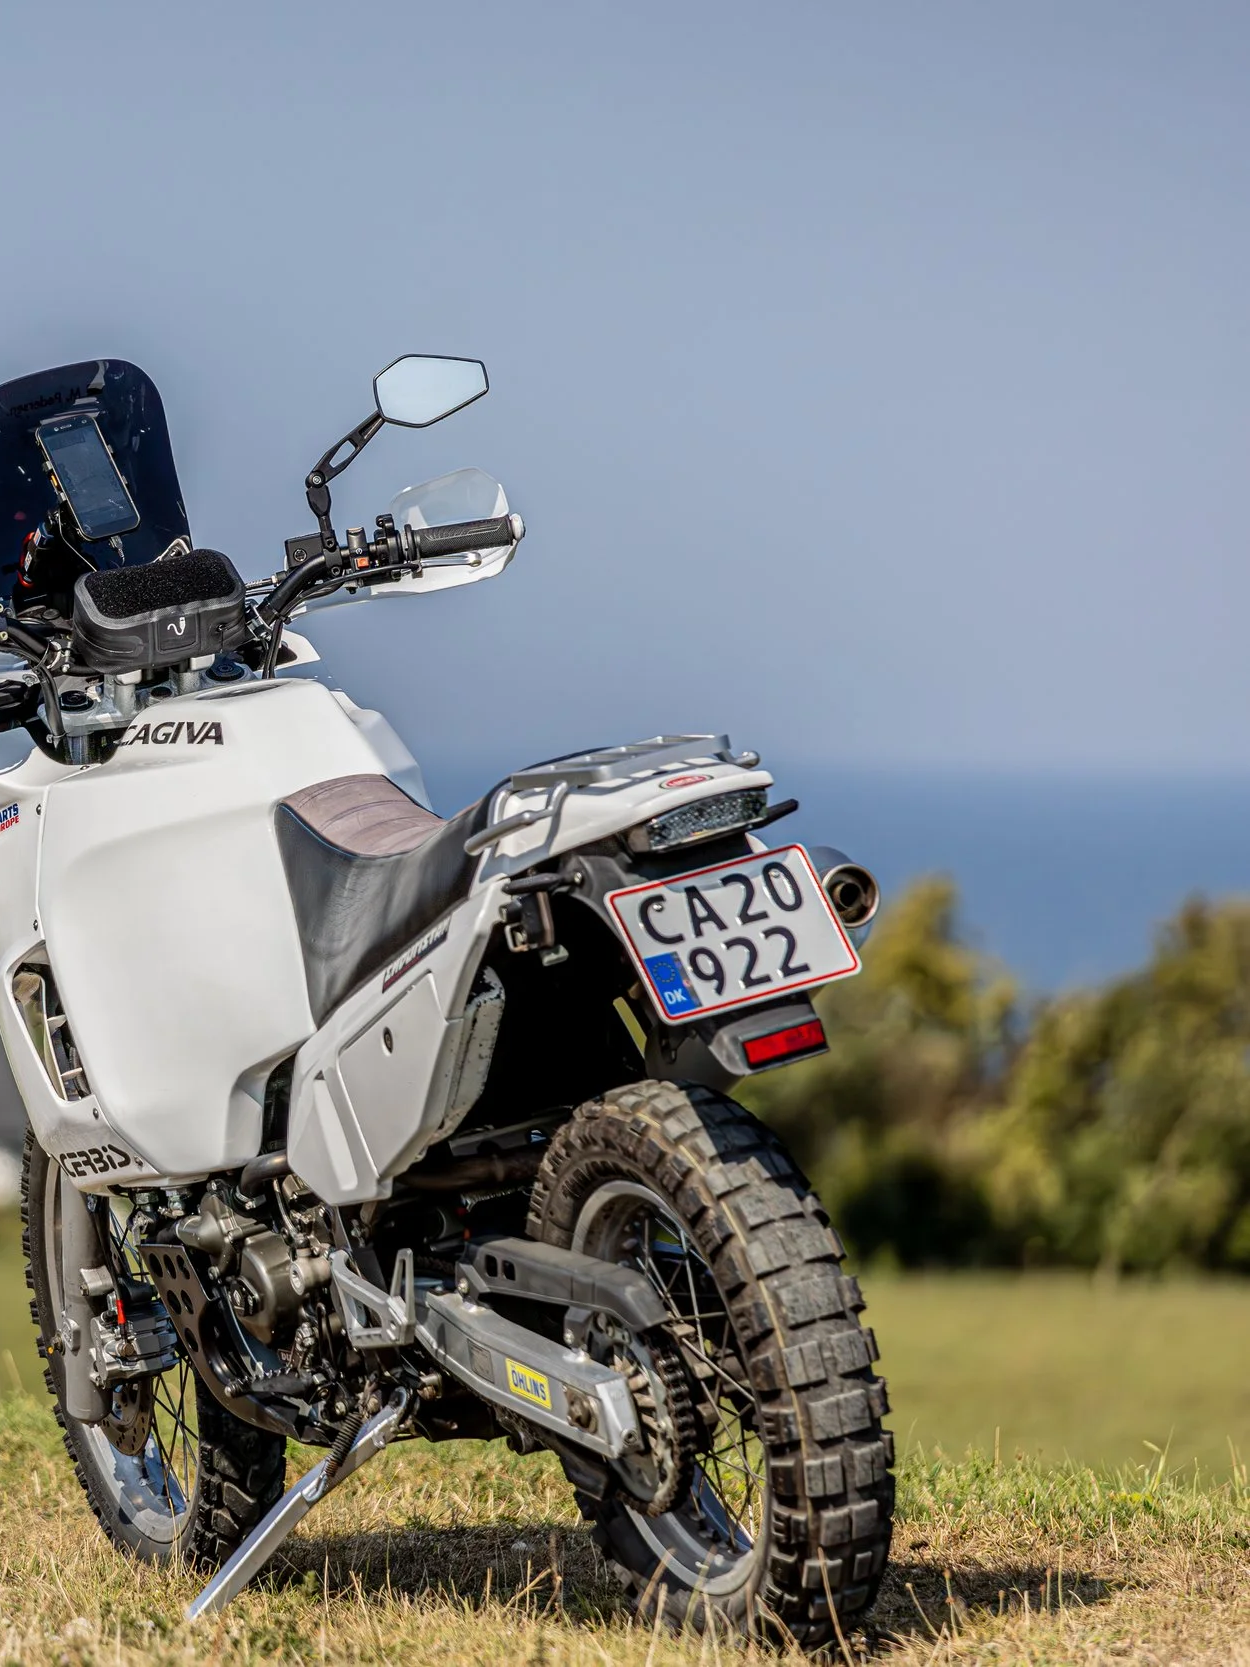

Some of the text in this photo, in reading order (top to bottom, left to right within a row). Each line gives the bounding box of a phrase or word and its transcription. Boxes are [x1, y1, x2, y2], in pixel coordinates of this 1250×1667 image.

[638, 861, 804, 945] CA20
[688, 925, 811, 996] 922
[664, 988, 688, 1005] DK
